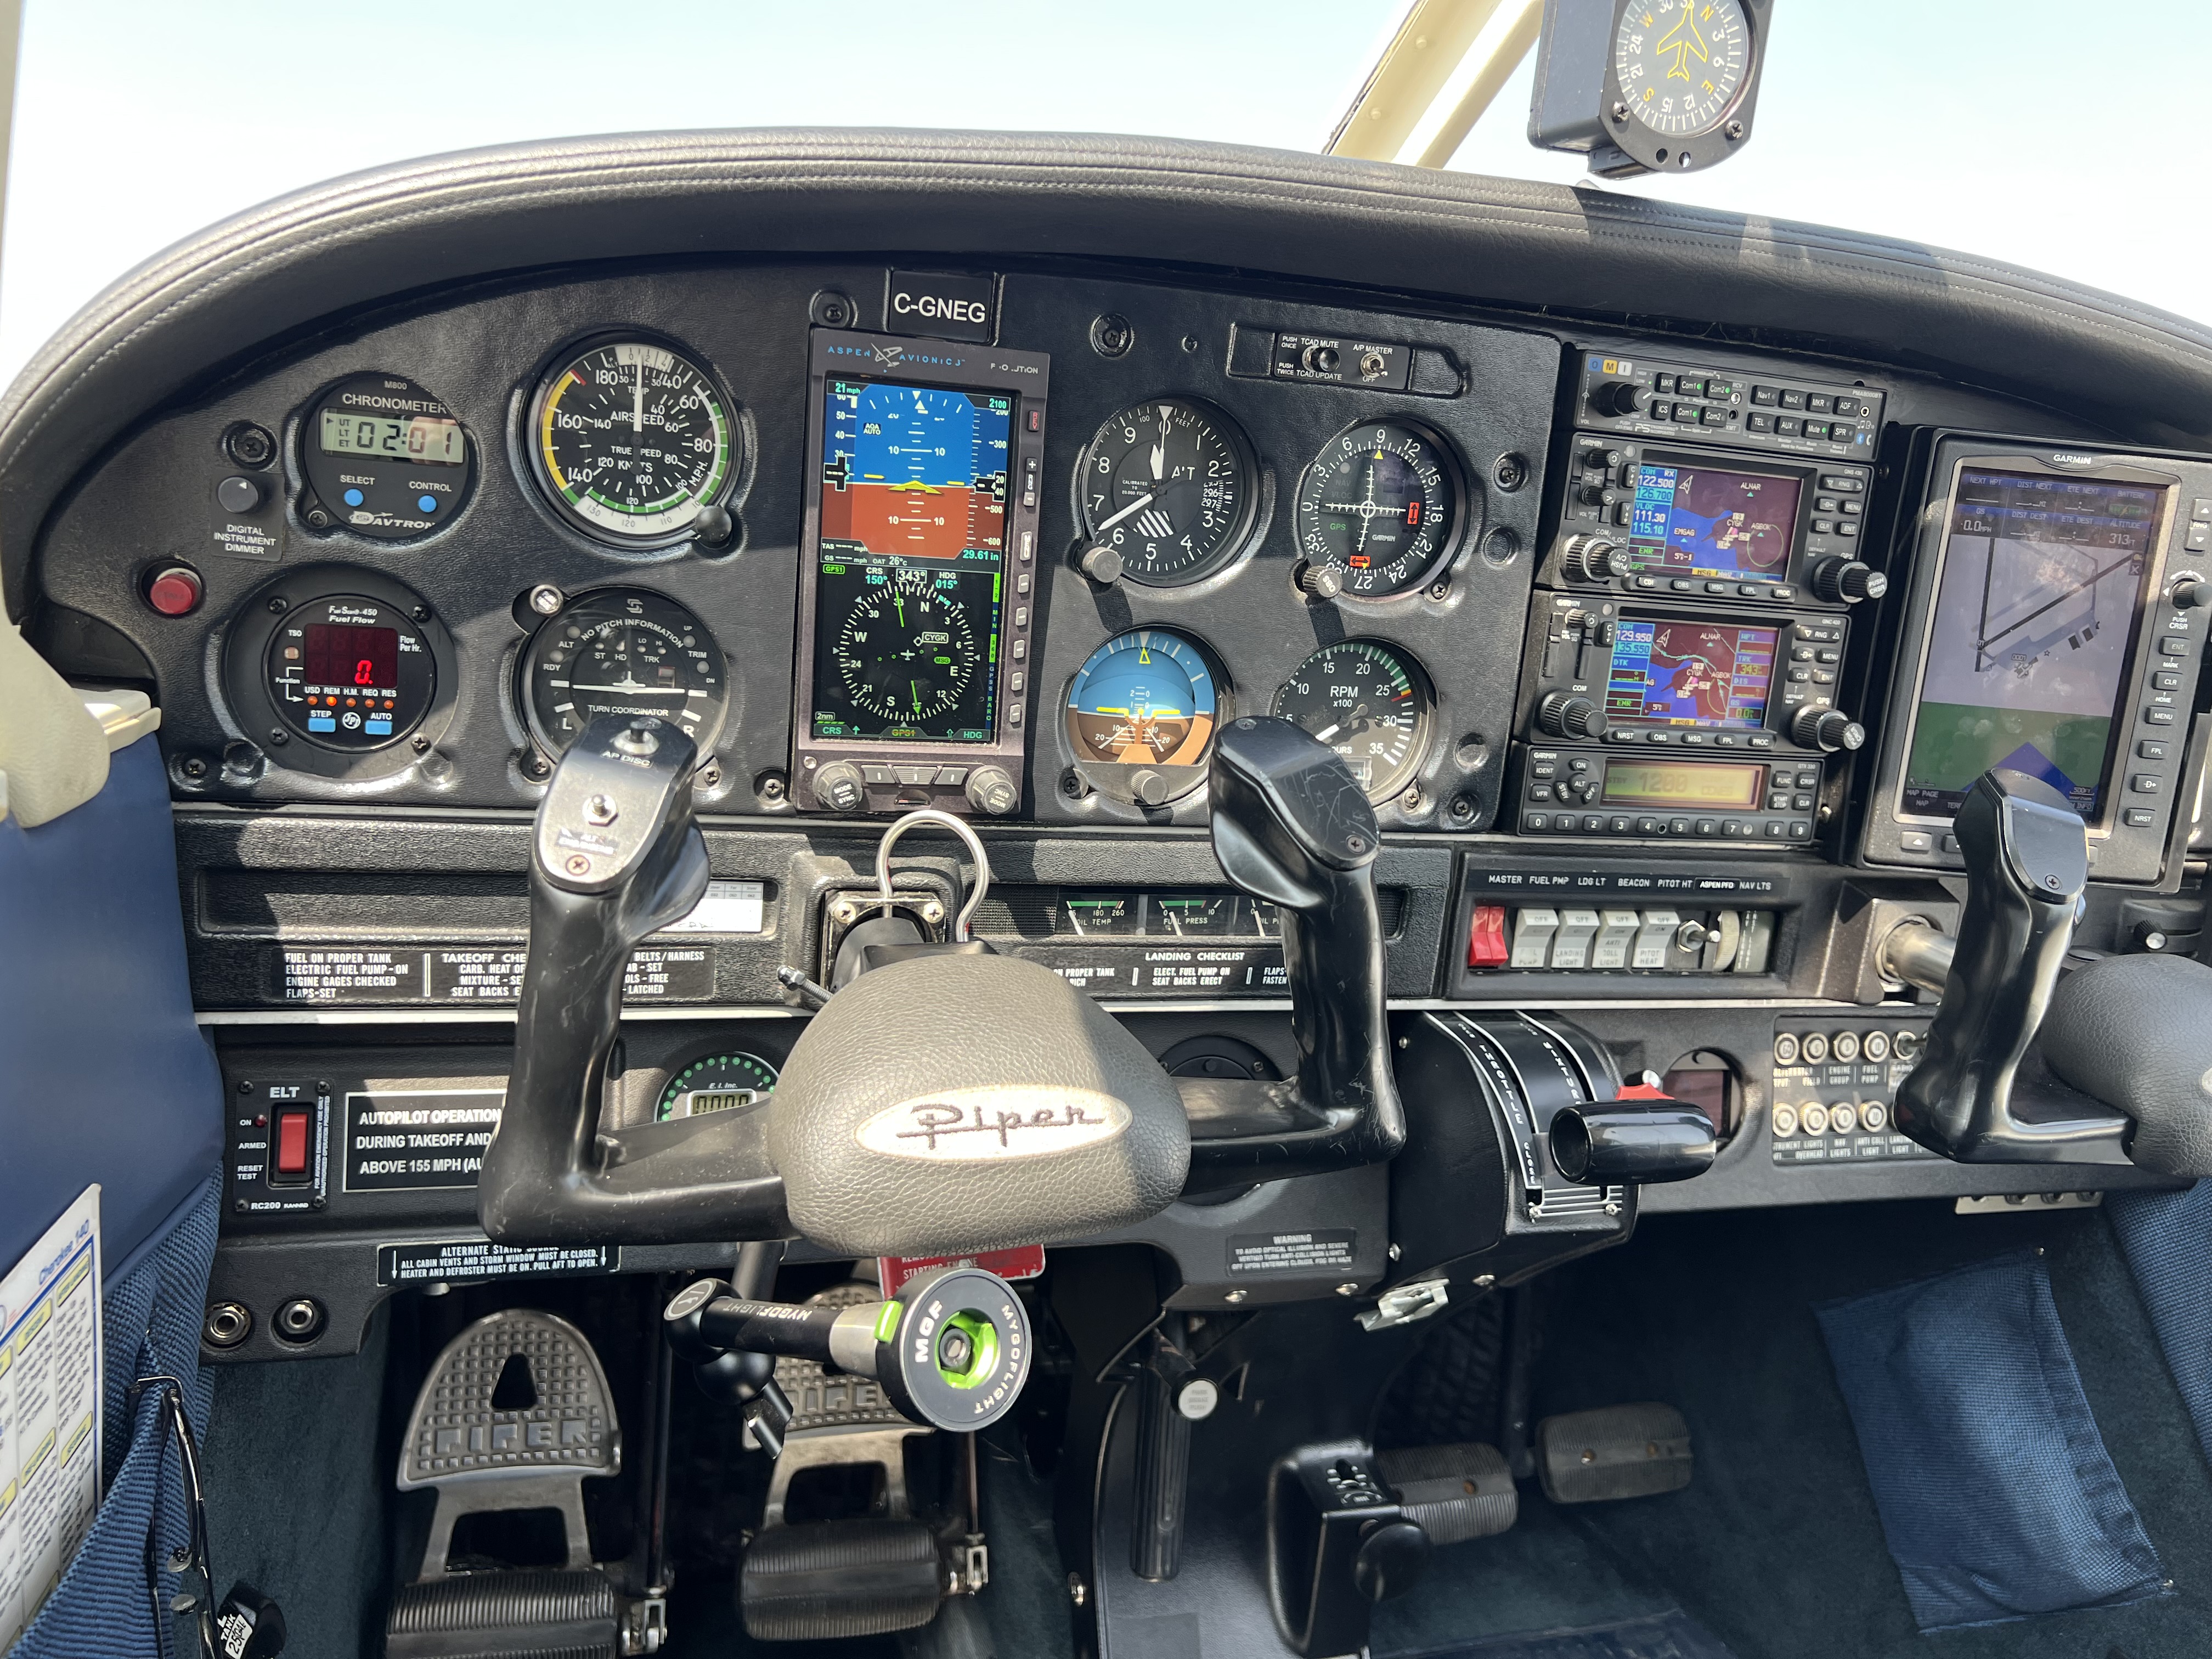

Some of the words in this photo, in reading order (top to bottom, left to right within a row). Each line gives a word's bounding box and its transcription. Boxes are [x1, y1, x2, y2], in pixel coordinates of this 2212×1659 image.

[1639, 12, 1654, 27] W
[894, 292, 985, 323] C-GNEG
[1301, 338, 1319, 346] TCAD
[828, 346, 871, 357] ASPEN
[1365, 346, 1393, 354] MASTER
[1316, 372, 1342, 381] UPDATE
[385, 381, 407, 390] M800
[836, 383, 846, 393] 21
[1661, 379, 1673, 387] MKR
[1681, 381, 1696, 390] Com1
[1710, 384, 1725, 393] Com2
[342, 393, 447, 414] CHRONOMETER
[989, 398, 1007, 409] 2100
[558, 414, 582, 429] 160
[1175, 418, 1190, 427] FEET
[1754, 418, 1764, 426] TEL
[1781, 421, 1793, 430] AUX
[611, 445, 632, 455] TRUE
[1098, 456, 1110, 473] 8
[2053, 454, 2092, 465] GARMIN
[340, 475, 375, 485] SELECT
[568, 467, 592, 482] 140
[409, 481, 452, 492] CONTROL
[1638, 475, 1674, 488] 122.500
[227, 524, 264, 535] DIGITAL
[213, 532, 276, 546] INSTRUMENT
[225, 543, 264, 554] DIMMER
[1146, 543, 1156, 559] 5
[963, 549, 989, 560] 29.61
[990, 551, 998, 561] in
[899, 569, 926, 581] 343°
[352, 616, 375, 624] Flow
[2169, 622, 2188, 630] CRSR
[581, 629, 595, 641] NO
[595, 619, 623, 632] PITCH
[625, 619, 684, 648] INFORMATION
[855, 631, 867, 642] W
[1323, 662, 1335, 673] 15
[1356, 664, 1370, 674] 20
[1330, 686, 1358, 697] RPM
[1375, 685, 1390, 696] 25
[588, 704, 610, 713] TURN
[611, 707, 669, 716] COORDINATOR
[1383, 715, 1397, 726] 30
[823, 726, 842, 735] CRS
[963, 731, 982, 739] HDG
[602, 751, 620, 759] AP
[620, 755, 651, 766] DISC
[1536, 766, 1554, 775] IDENT
[834, 784, 853, 794] MODE
[838, 794, 855, 804] SYNC
[1488, 875, 1522, 884] MASTER
[1529, 876, 1550, 884] FUEL
[1552, 877, 1569, 885] PMP
[1578, 878, 1594, 886] LDG
[1595, 878, 1606, 886] LT
[1617, 878, 1650, 888] BEACON
[1657, 879, 1680, 888] PITOT
[1681, 880, 1693, 888] HT
[1740, 881, 1755, 890] NAV
[1757, 882, 1771, 890] LTS
[286, 953, 307, 963] FUEL
[312, 953, 324, 963] ON
[328, 953, 364, 963] PROPER
[368, 953, 392, 963] TANK
[442, 953, 495, 963] TAKEOFF
[1145, 952, 1192, 962] LANDING
[1197, 952, 1245, 961] CHECKLIST
[286, 964, 331, 975] ELECTRIC
[337, 964, 359, 975] FUEL
[1153, 968, 1176, 977] ELECT.
[1179, 968, 1196, 977] FUEL
[1198, 967, 1217, 976] PUMP
[1220, 967, 1231, 976] ON
[286, 977, 319, 987] ENGINE
[323, 976, 352, 987] GAGES
[355, 976, 397, 987] CHECKED
[1152, 977, 1171, 986] SEAT
[1173, 976, 1198, 985] BACKS
[1200, 976, 1222, 985] ERECT
[286, 988, 337, 998] FLAPS-SET
[627, 985, 664, 994] LATCHED
[1829, 1066, 1850, 1074] ENGINE
[1863, 1065, 1878, 1074] FUEL
[1479, 1044, 1524, 1125] THROTTLE
[1861, 1075, 1878, 1084] PUMP
[269, 1087, 300, 1098] ELT
[359, 1110, 432, 1125] AUTOPILOT
[432, 1108, 501, 1123] OPERATION
[896, 1103, 1108, 1150] Piper
[356, 1136, 405, 1149] DURING
[408, 1134, 464, 1148] TAKEOFF
[466, 1133, 492, 1146] AND
[359, 1160, 406, 1174] ABOVE
[409, 1159, 431, 1172] 155
[432, 1159, 461, 1171] MPH
[1273, 1234, 1312, 1244] WARNING
[442, 1245, 489, 1257] ALTERNATE
[401, 1260, 414, 1269] ALL
[416, 1259, 437, 1268] CABIN
[439, 1257, 461, 1267] VENTS
[464, 1257, 478, 1266] AND
[480, 1255, 504, 1265] STORM
[506, 1254, 535, 1263] WINDOW
[538, 1251, 557, 1261] MUST
[561, 1251, 569, 1260] BE
[570, 1249, 598, 1259] CLOSED.
[401, 1268, 427, 1278] HEATER
[430, 1268, 445, 1277] AND
[447, 1266, 485, 1276] DEFROSTER
[487, 1265, 506, 1274] MUST
[509, 1264, 518, 1273] BE
[533, 1261, 550, 1271] PULL
[552, 1260, 565, 1269] AFT
[567, 1260, 576, 1268] TO
[578, 1259, 598, 1268] OPEN.
[724, 1303, 813, 1322] MYGOFLIGHT
[974, 1305, 1020, 1414] MYGOFLIGHT
[436, 1419, 586, 1454] PIPER
